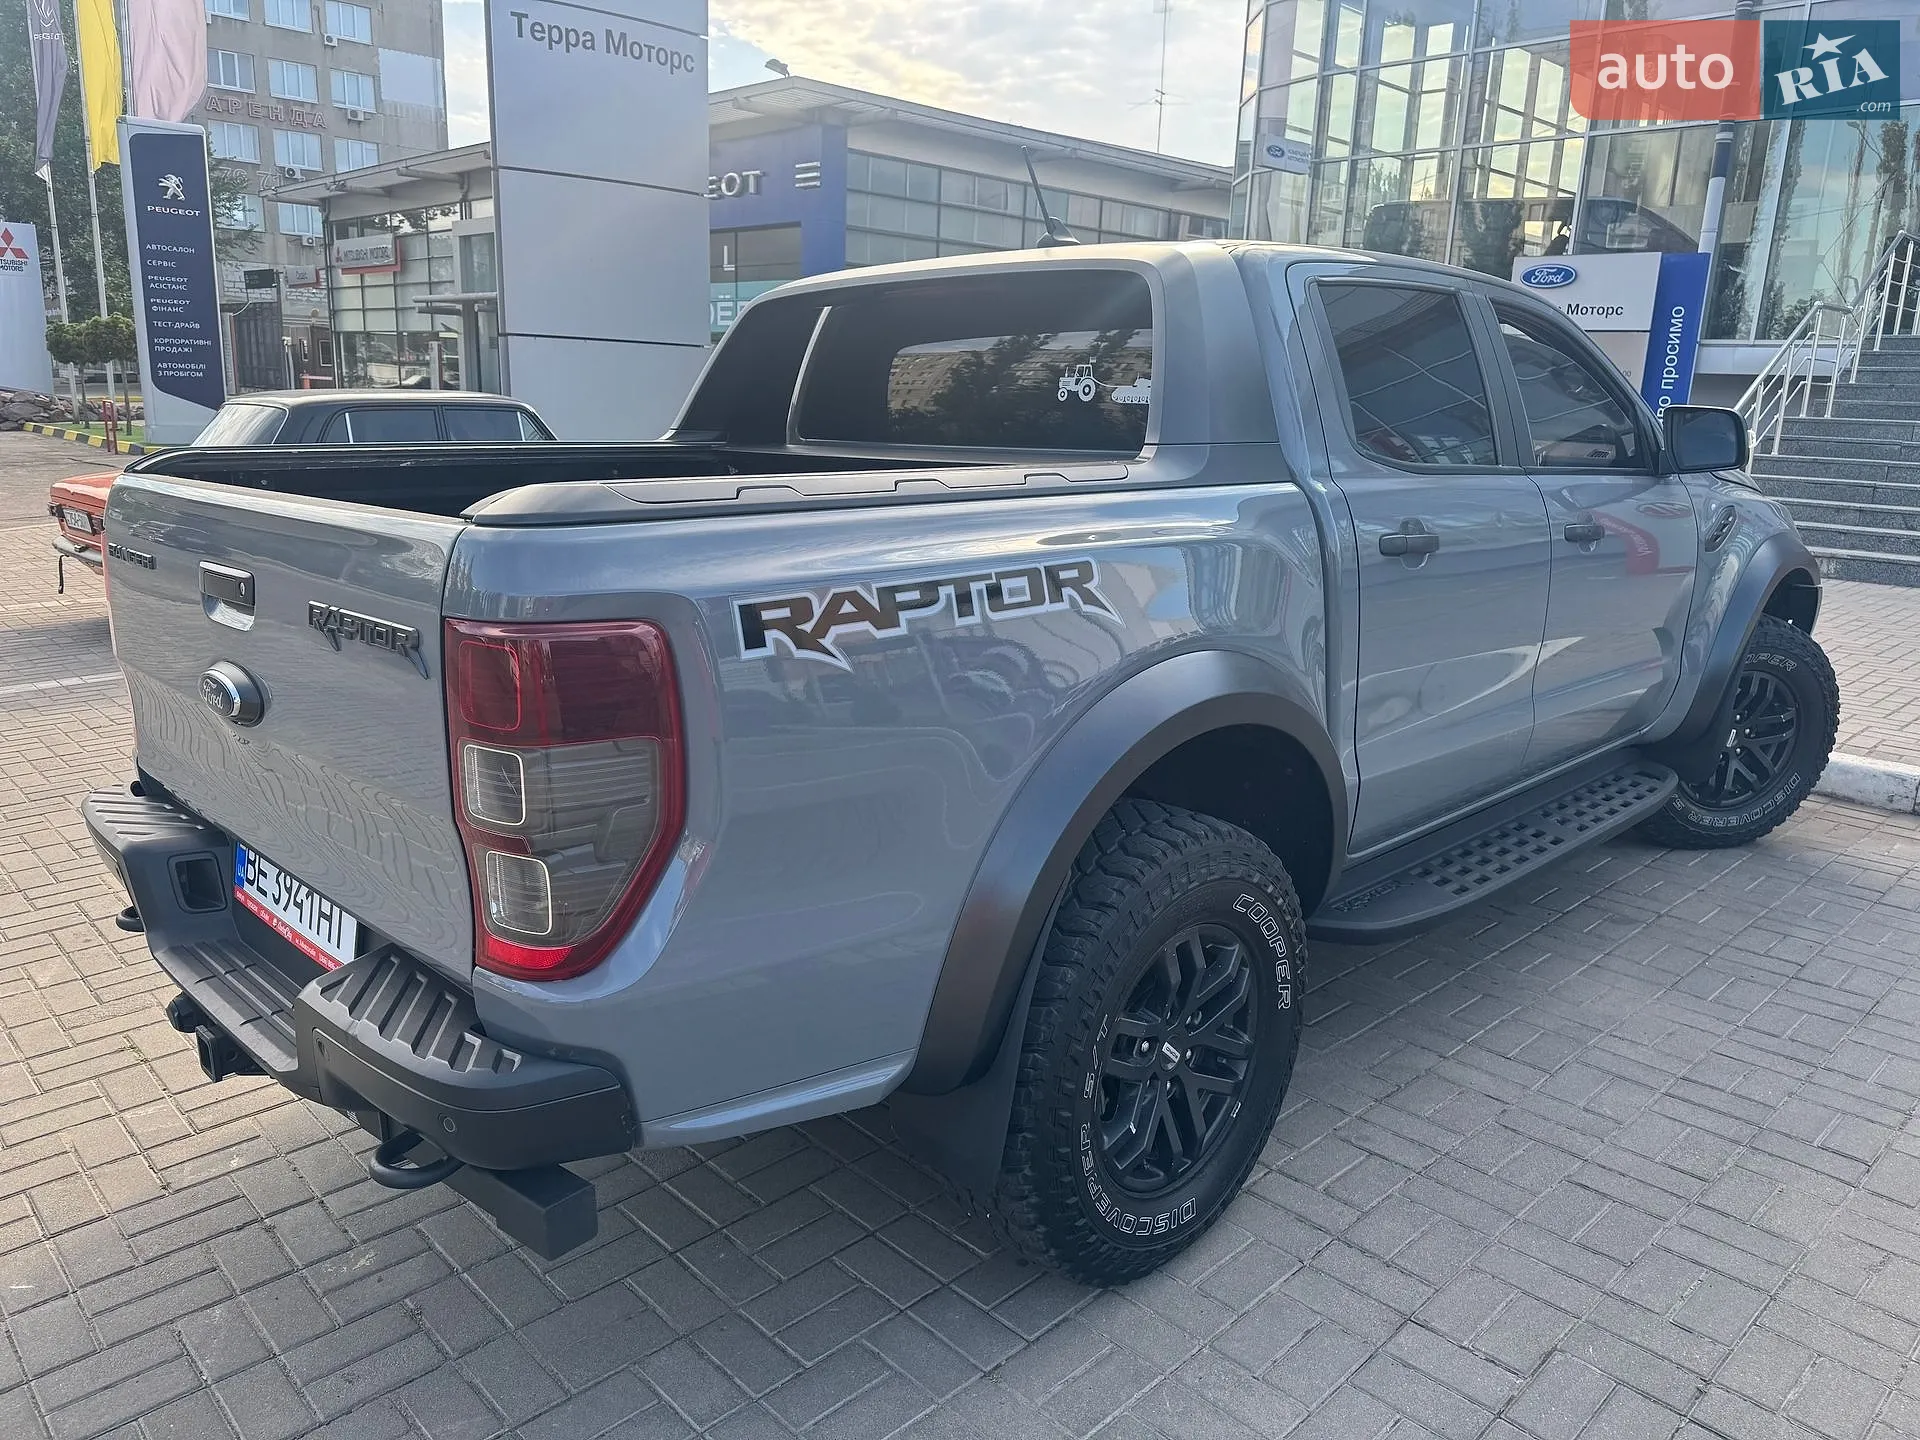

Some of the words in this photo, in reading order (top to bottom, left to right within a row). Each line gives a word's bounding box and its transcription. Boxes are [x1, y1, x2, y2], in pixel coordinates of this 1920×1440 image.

[510, 11, 596, 53] Терра
[605, 28, 695, 75] Моторс
[206, 95, 328, 129] АРЕНДА
[147, 205, 201, 217] PEUGEOT
[146, 244, 195, 254] АВТОСАЛОН
[147, 259, 177, 268] СЕРВІС
[148, 275, 188, 283] PEUGEOT
[1531, 268, 1566, 284] Ford
[149, 283, 188, 291] АСІСТАНС
[151, 305, 184, 313] ФІНАНС
[1566, 303, 1624, 319] Моторс
[153, 320, 200, 329] ТЕСТ-ДРАЙВ
[154, 338, 212, 347] КОРПОРАТИВНІ
[1661, 306, 1685, 390] просимо
[154, 346, 193, 354] ПРОДАЖІ
[157, 362, 206, 370] АВТОМОБІЛІ
[163, 370, 203, 378] ПРОБІГОМ
[728, 555, 1127, 674] RAPTOR
[308, 600, 430, 680] RAPTOR
[202, 678, 224, 710] Ford
[1232, 893, 1291, 1010] COOPER
[1080, 1121, 1197, 1236] DISCOVERER
